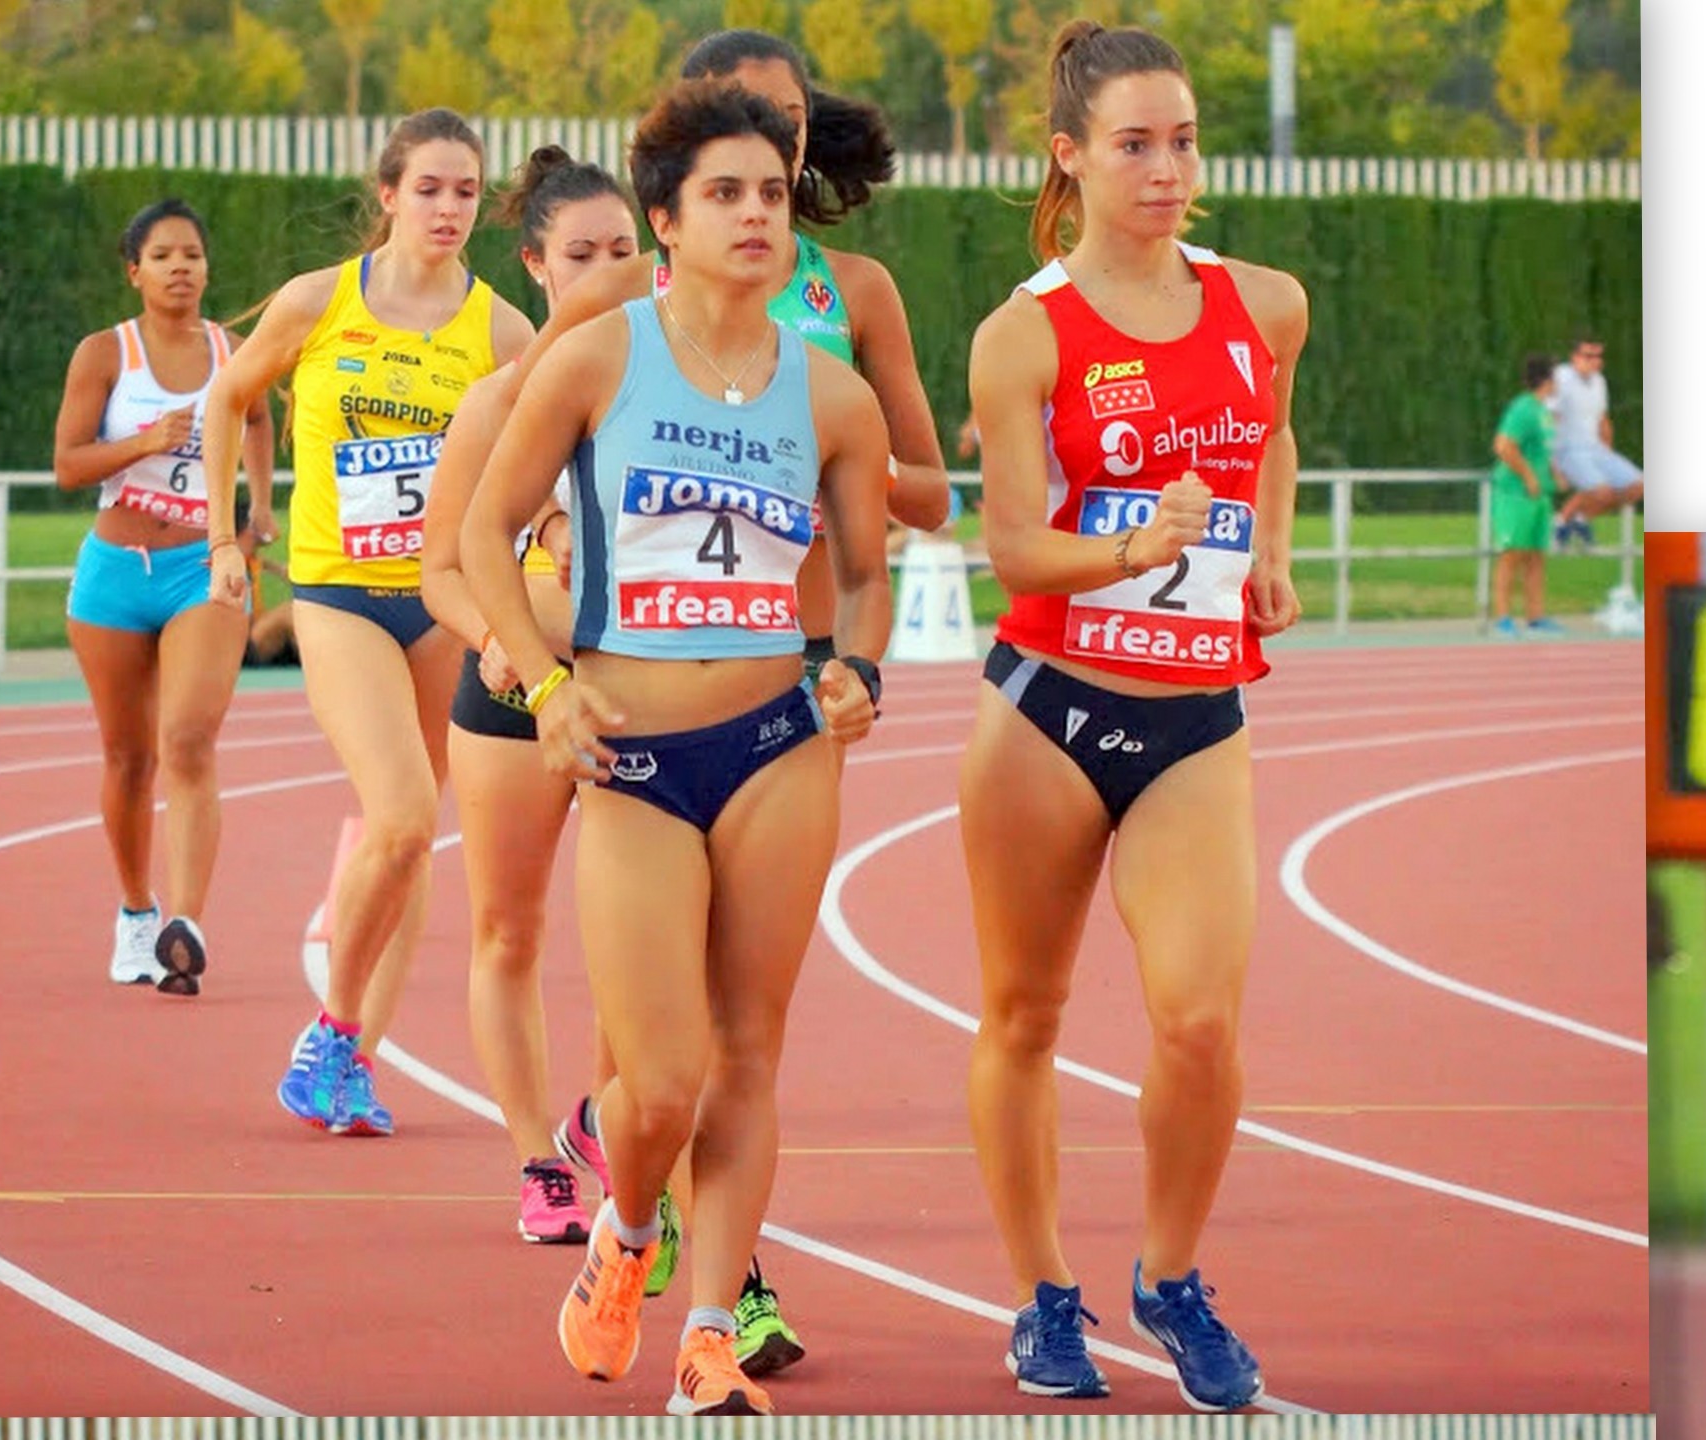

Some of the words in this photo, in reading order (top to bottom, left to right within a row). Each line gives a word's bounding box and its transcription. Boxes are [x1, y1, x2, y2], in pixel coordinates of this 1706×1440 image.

[339, 395, 454, 432] SCORPIO-7
[1154, 406, 1269, 465] alquiber
[652, 419, 773, 464] nerja
[169, 461, 190, 494] 6
[395, 473, 425, 517] 5
[125, 492, 208, 524] rfea.e
[1095, 496, 1241, 542] Joa
[351, 527, 423, 557] rfea
[696, 515, 742, 576] 4
[1149, 552, 1191, 611] 2
[632, 586, 791, 627] rfea.es
[1078, 614, 1233, 664] rfea.es
